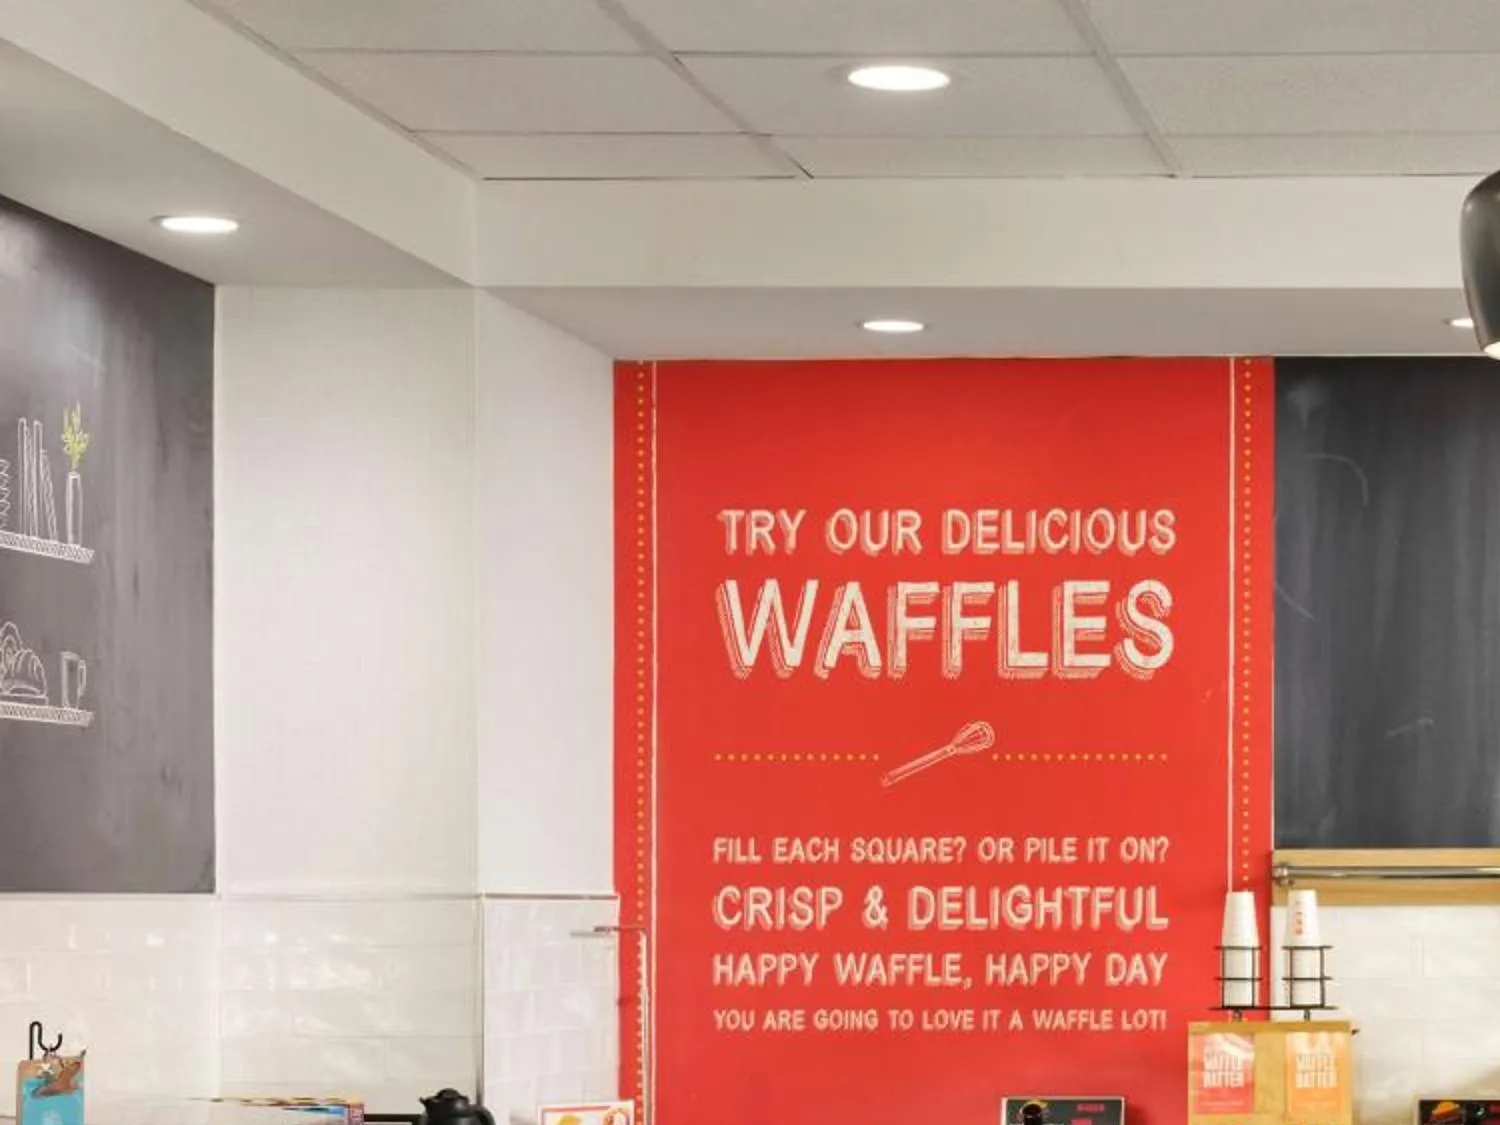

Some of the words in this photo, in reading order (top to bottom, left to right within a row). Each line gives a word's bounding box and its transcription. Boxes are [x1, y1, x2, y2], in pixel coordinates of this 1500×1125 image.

[717, 507, 807, 556] TRY
[825, 507, 924, 557] OUR
[941, 507, 1177, 557] DELICIOUS
[716, 577, 1175, 681] WAFFLES
[713, 836, 762, 863] FILL
[772, 836, 840, 863] EACH
[850, 835, 967, 864] SQUARE?
[977, 836, 1014, 863] OR
[1025, 836, 1078, 863] PILE
[1087, 836, 1110, 862] IT
[1120, 835, 1170, 863] ON?
[713, 885, 843, 930] CRISP
[862, 885, 889, 929] &
[908, 884, 1169, 931] DELIGHTFUL
[712, 952, 820, 987] HAPPY
[833, 951, 973, 990] WAFFLE,
[985, 952, 1092, 986] HAPPY
[1105, 951, 1169, 987] DAY
[713, 1008, 755, 1032] YOU
[762, 1009, 805, 1031] ARE
[813, 1008, 879, 1031] GOING
[888, 1009, 914, 1030] TO
[922, 1008, 975, 1031] LOVE
[982, 1009, 1001, 1030] IT
[1008, 1009, 1024, 1031] A
[1032, 1009, 1114, 1031] WAFFLE
[1121, 1008, 1168, 1031] LOT!
